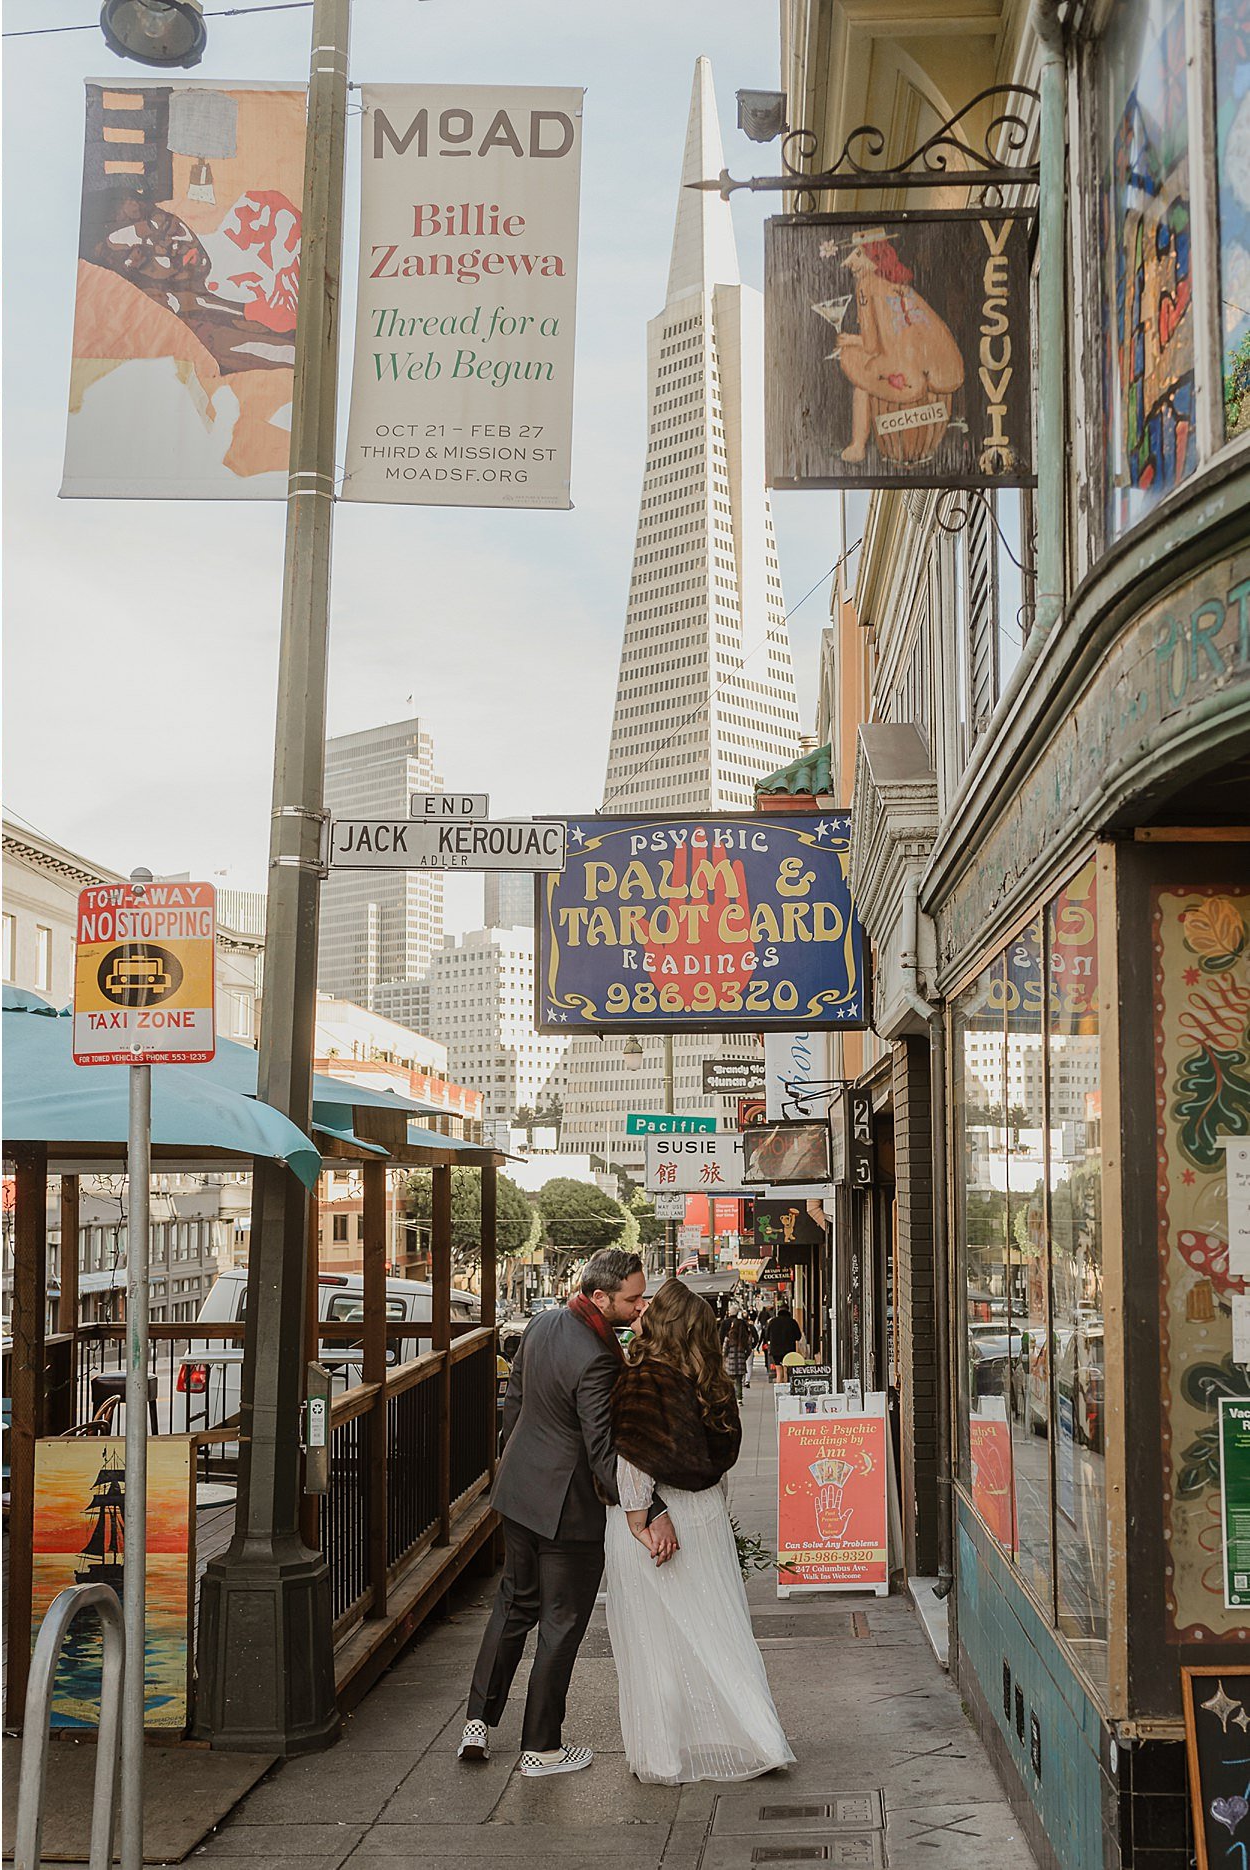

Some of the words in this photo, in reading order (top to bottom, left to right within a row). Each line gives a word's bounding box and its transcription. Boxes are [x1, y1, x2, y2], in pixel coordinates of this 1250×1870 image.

[411, 203, 526, 237] Billie
[369, 245, 566, 284] Zangewa
[371, 306, 481, 338] Thread
[481, 306, 535, 344] for
[540, 316, 560, 337] a
[979, 219, 1015, 476] VESUVIO
[372, 352, 442, 382] Web
[450, 350, 555, 388] Begun
[881, 406, 944, 431] cocktails
[375, 425, 418, 437] OCT
[425, 425, 445, 437] 21
[471, 425, 511, 437] FEB
[519, 426, 544, 438] 27
[360, 446, 420, 459] THIRD
[425, 447, 438, 459] &
[443, 446, 526, 461] MISSION
[532, 448, 557, 461] ST
[385, 467, 528, 482] MOADSF.ORG
[425, 797, 473, 814] END
[339, 825, 408, 852] JACK
[439, 827, 558, 855] KEROUAC
[630, 828, 769, 856] PSYCHIC
[421, 855, 468, 866] ADLER
[583, 859, 740, 902] PALM
[775, 857, 816, 897] &
[87, 887, 202, 909] TOW-AWAY
[81, 912, 113, 942] NO
[118, 911, 211, 937] STOPPING
[559, 904, 709, 947] TAROT
[718, 902, 844, 944] CARD
[622, 947, 780, 975] READINGS
[605, 980, 799, 1014] 986.9320
[88, 1012, 128, 1030] TAXI
[137, 1012, 195, 1028] ZONE
[91, 1055, 110, 1063] TOWED
[112, 1054, 144, 1062] VEHICLES
[146, 1053, 169, 1061] PHONE
[172, 1053, 206, 1061] 553-1235
[713, 1065, 749, 1075] Brandy
[707, 1076, 747, 1087] Hunan
[636, 1119, 707, 1133] Pacific
[657, 1141, 716, 1154] SUSIE
[793, 1366, 831, 1374] NEVERLAND
[787, 1426, 816, 1436] Palm
[820, 1425, 829, 1435] &
[832, 1424, 877, 1436] Psychic
[799, 1436, 848, 1446] Readings
[851, 1435, 864, 1445] by
[816, 1446, 846, 1458] Ann
[802, 1541, 823, 1549] Solve
[825, 1541, 841, 1549] Any
[843, 1540, 878, 1548] Problems
[790, 1550, 874, 1563] 415-986-9320
[795, 1564, 810, 1573] 247
[812, 1564, 850, 1572] Columbus
[853, 1563, 868, 1572] Ave.
